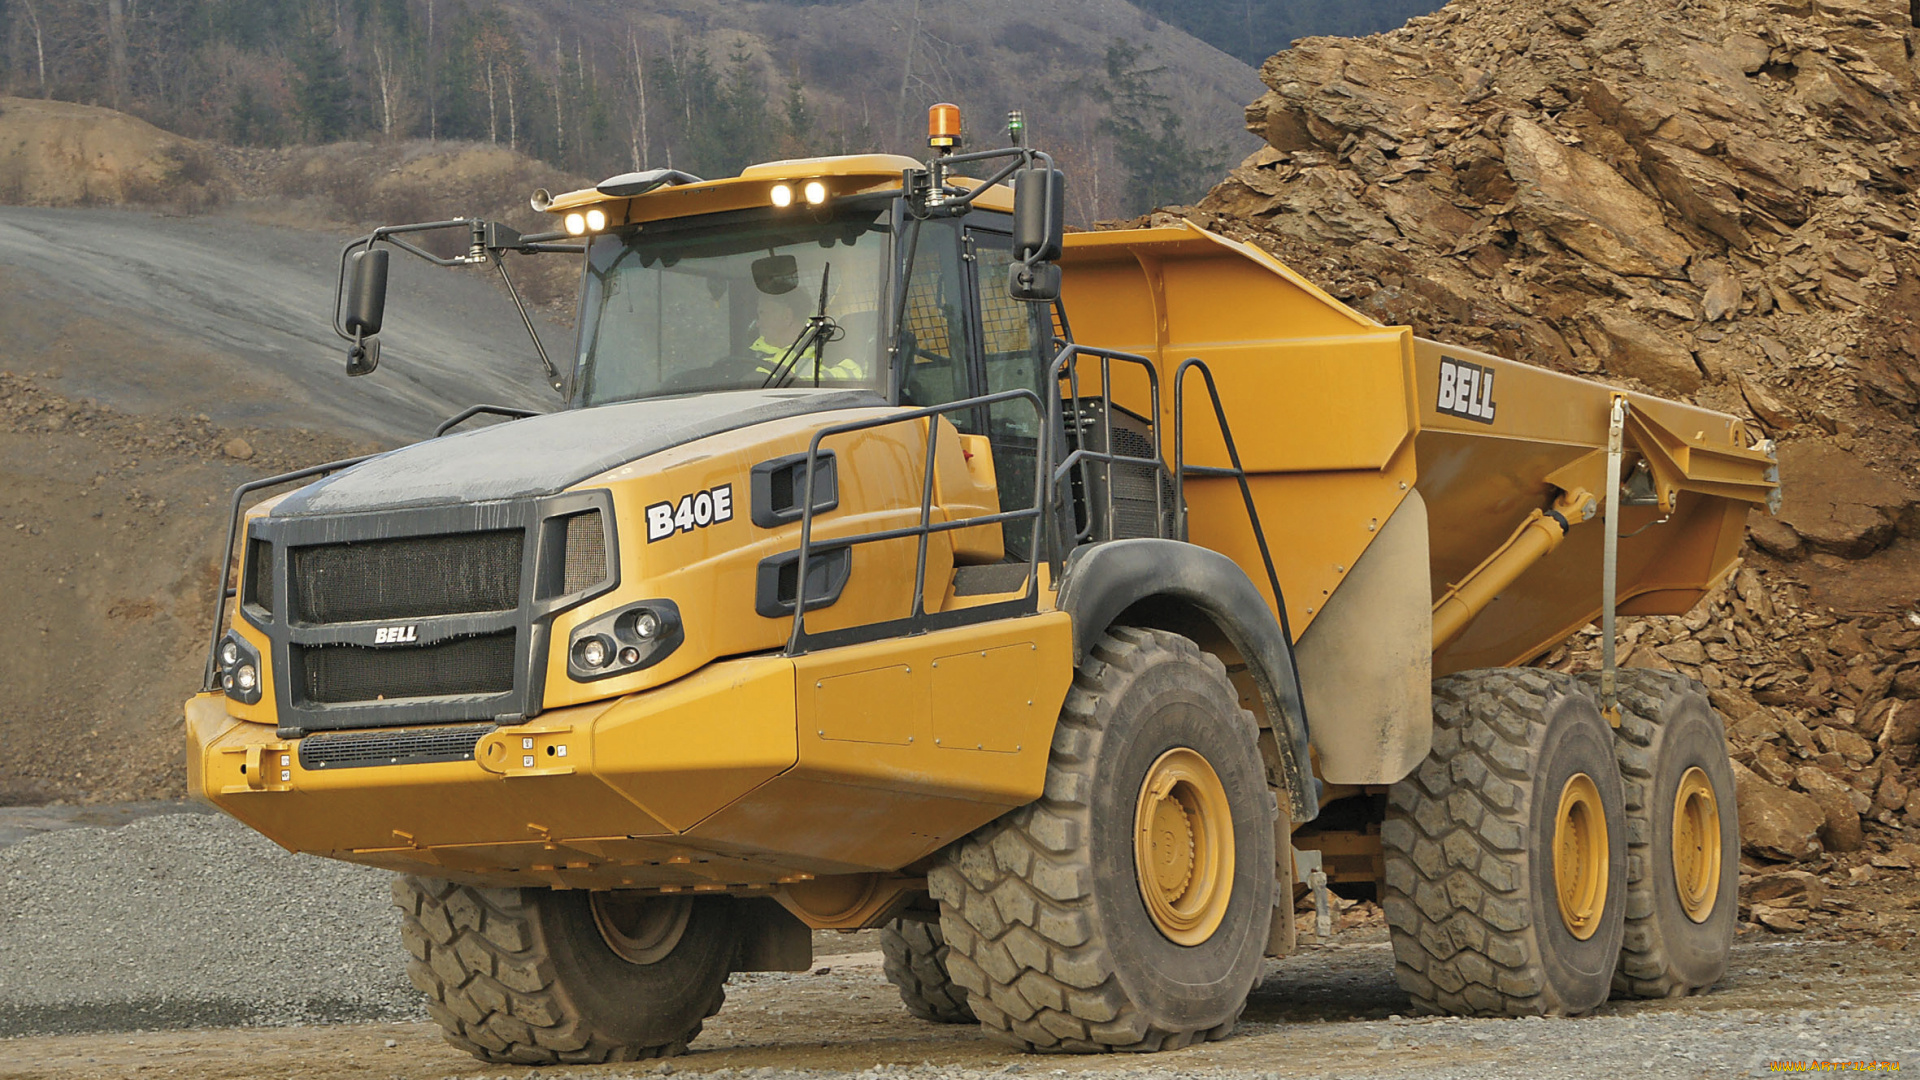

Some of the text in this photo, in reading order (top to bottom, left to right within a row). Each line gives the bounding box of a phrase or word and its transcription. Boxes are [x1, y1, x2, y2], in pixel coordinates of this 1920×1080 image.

[1437, 355, 1495, 424] BELL
[645, 483, 733, 544] B40E
[374, 625, 418, 645] BELL
